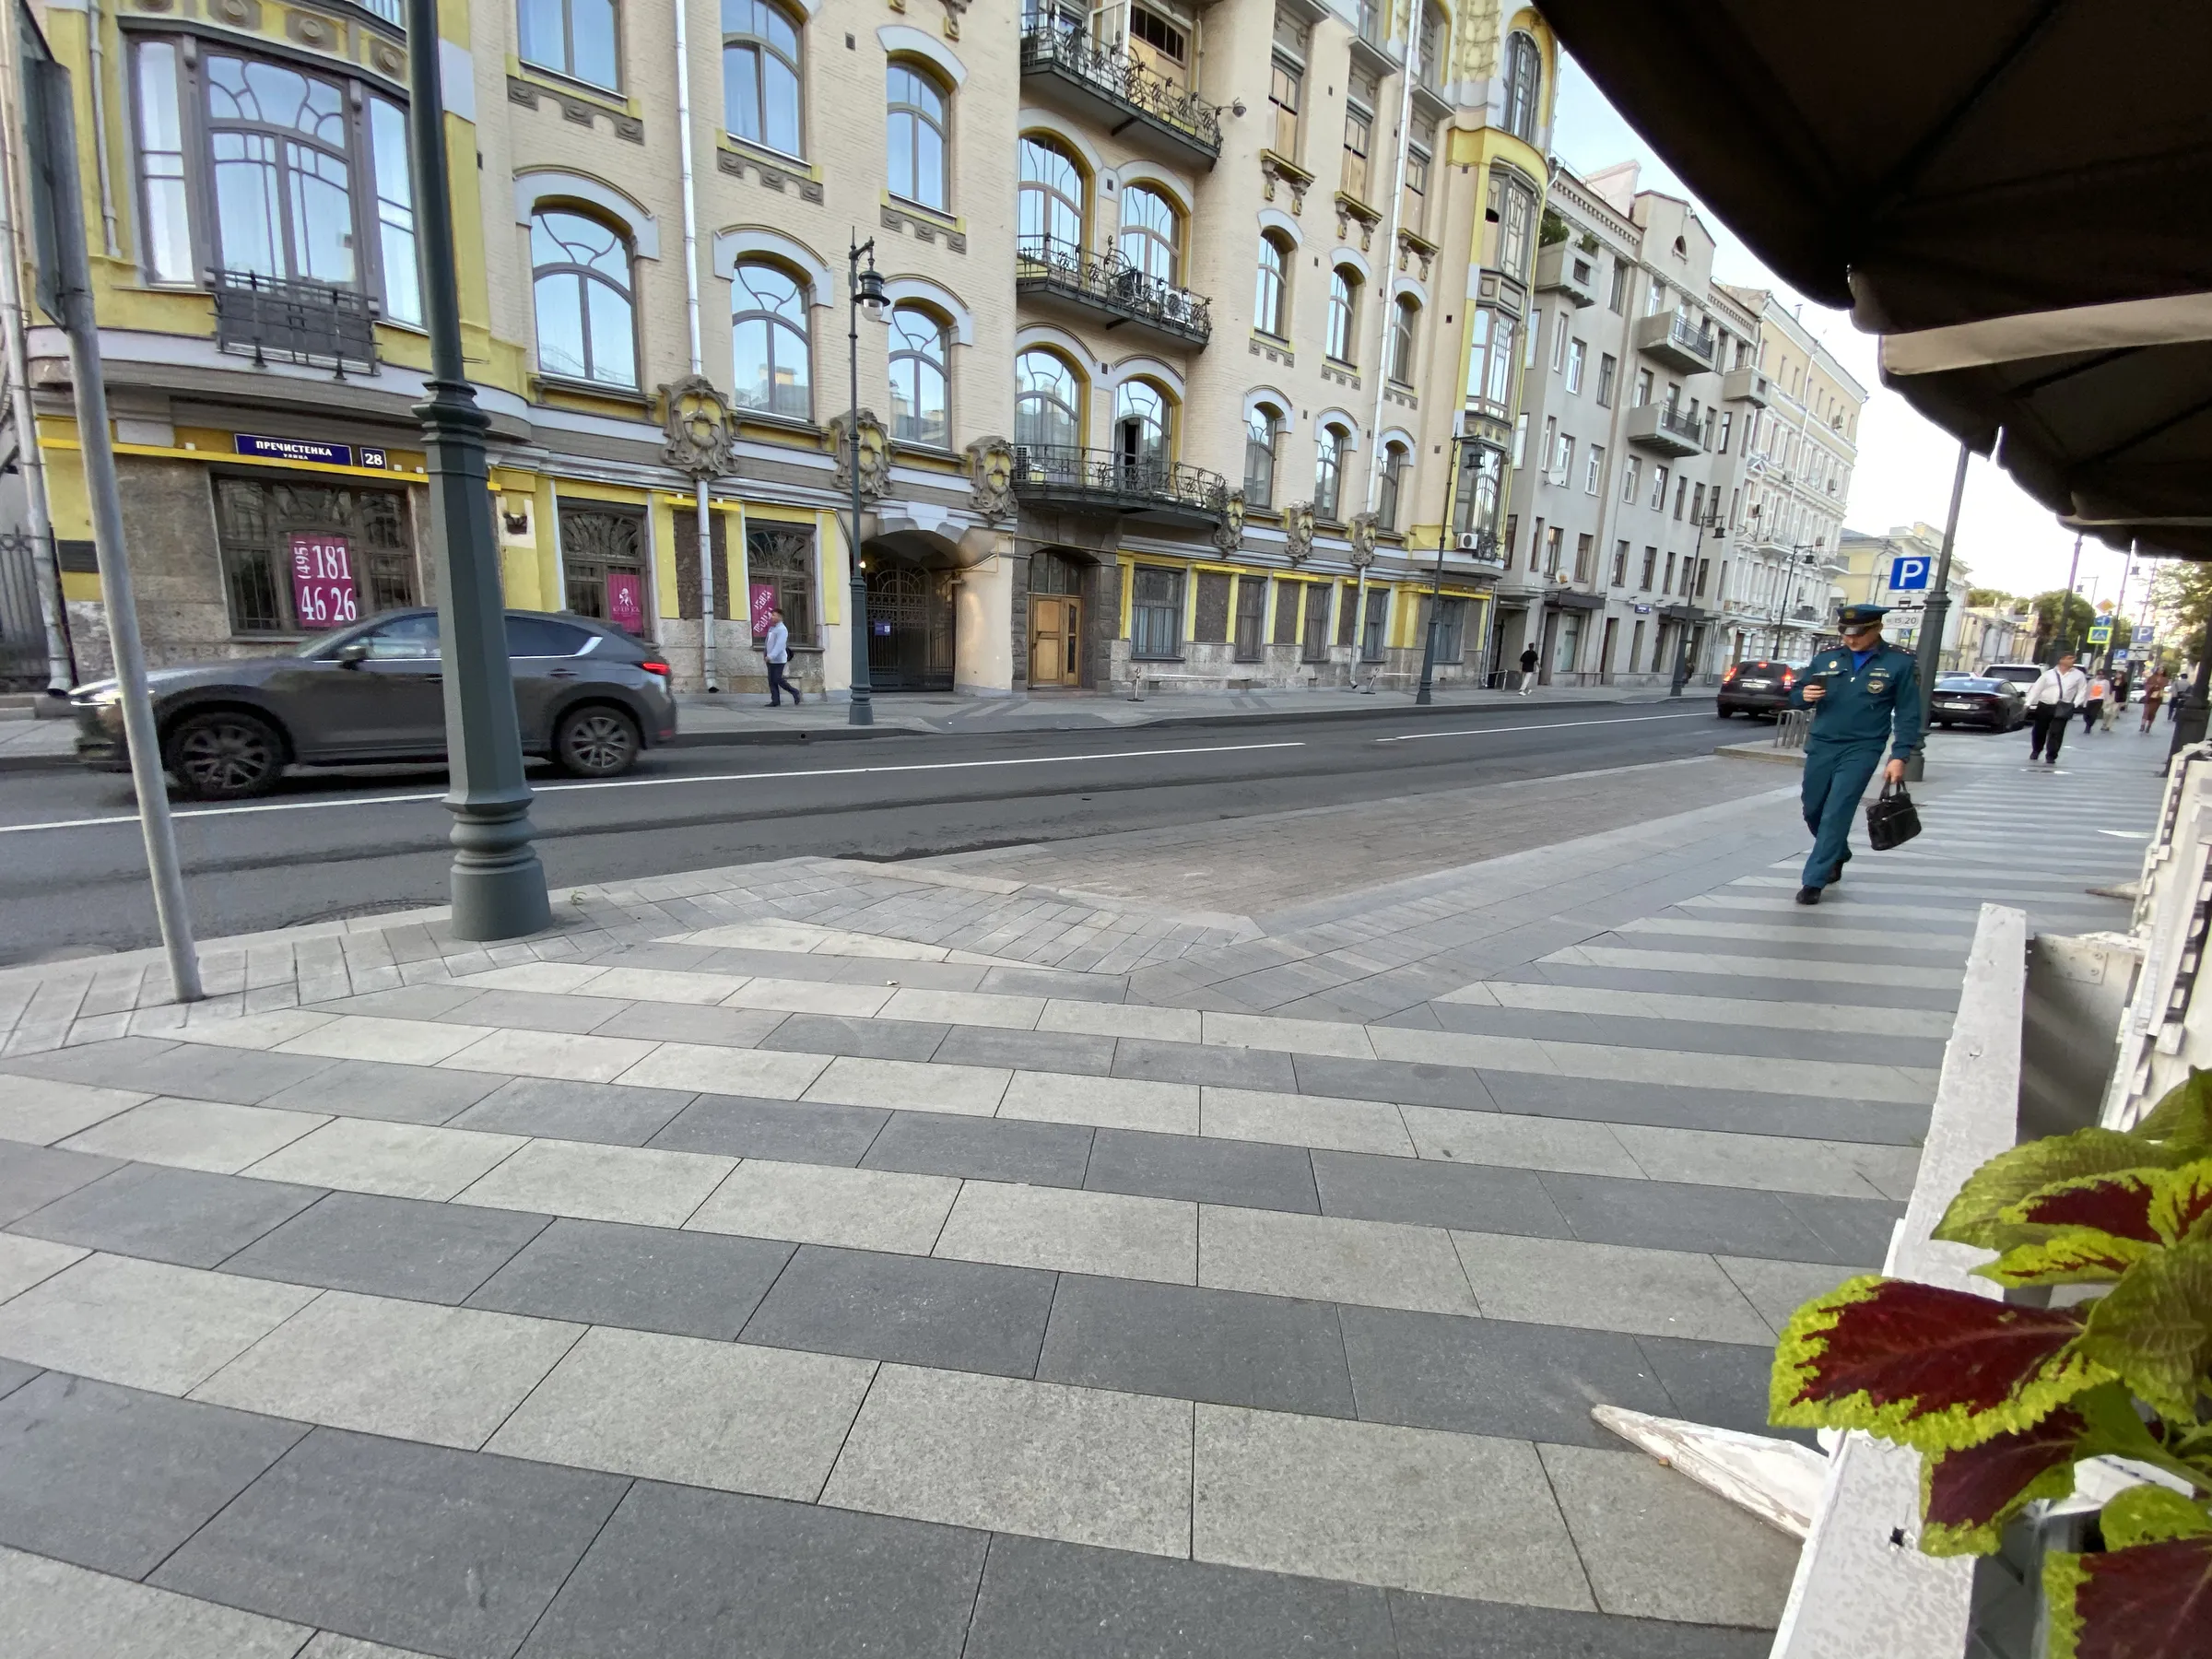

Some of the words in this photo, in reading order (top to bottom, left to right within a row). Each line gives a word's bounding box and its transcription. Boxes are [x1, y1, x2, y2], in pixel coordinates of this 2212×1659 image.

[255, 441, 333, 456] ПРЕЧИСТЕНКА
[364, 453, 383, 465] 28
[294, 540, 312, 579] (495)
[312, 545, 352, 580] 181
[1899, 559, 1924, 587] P
[301, 585, 326, 621] 46
[331, 587, 357, 621] 26
[1904, 617, 1917, 625] 20
[2137, 627, 2151, 641] P
